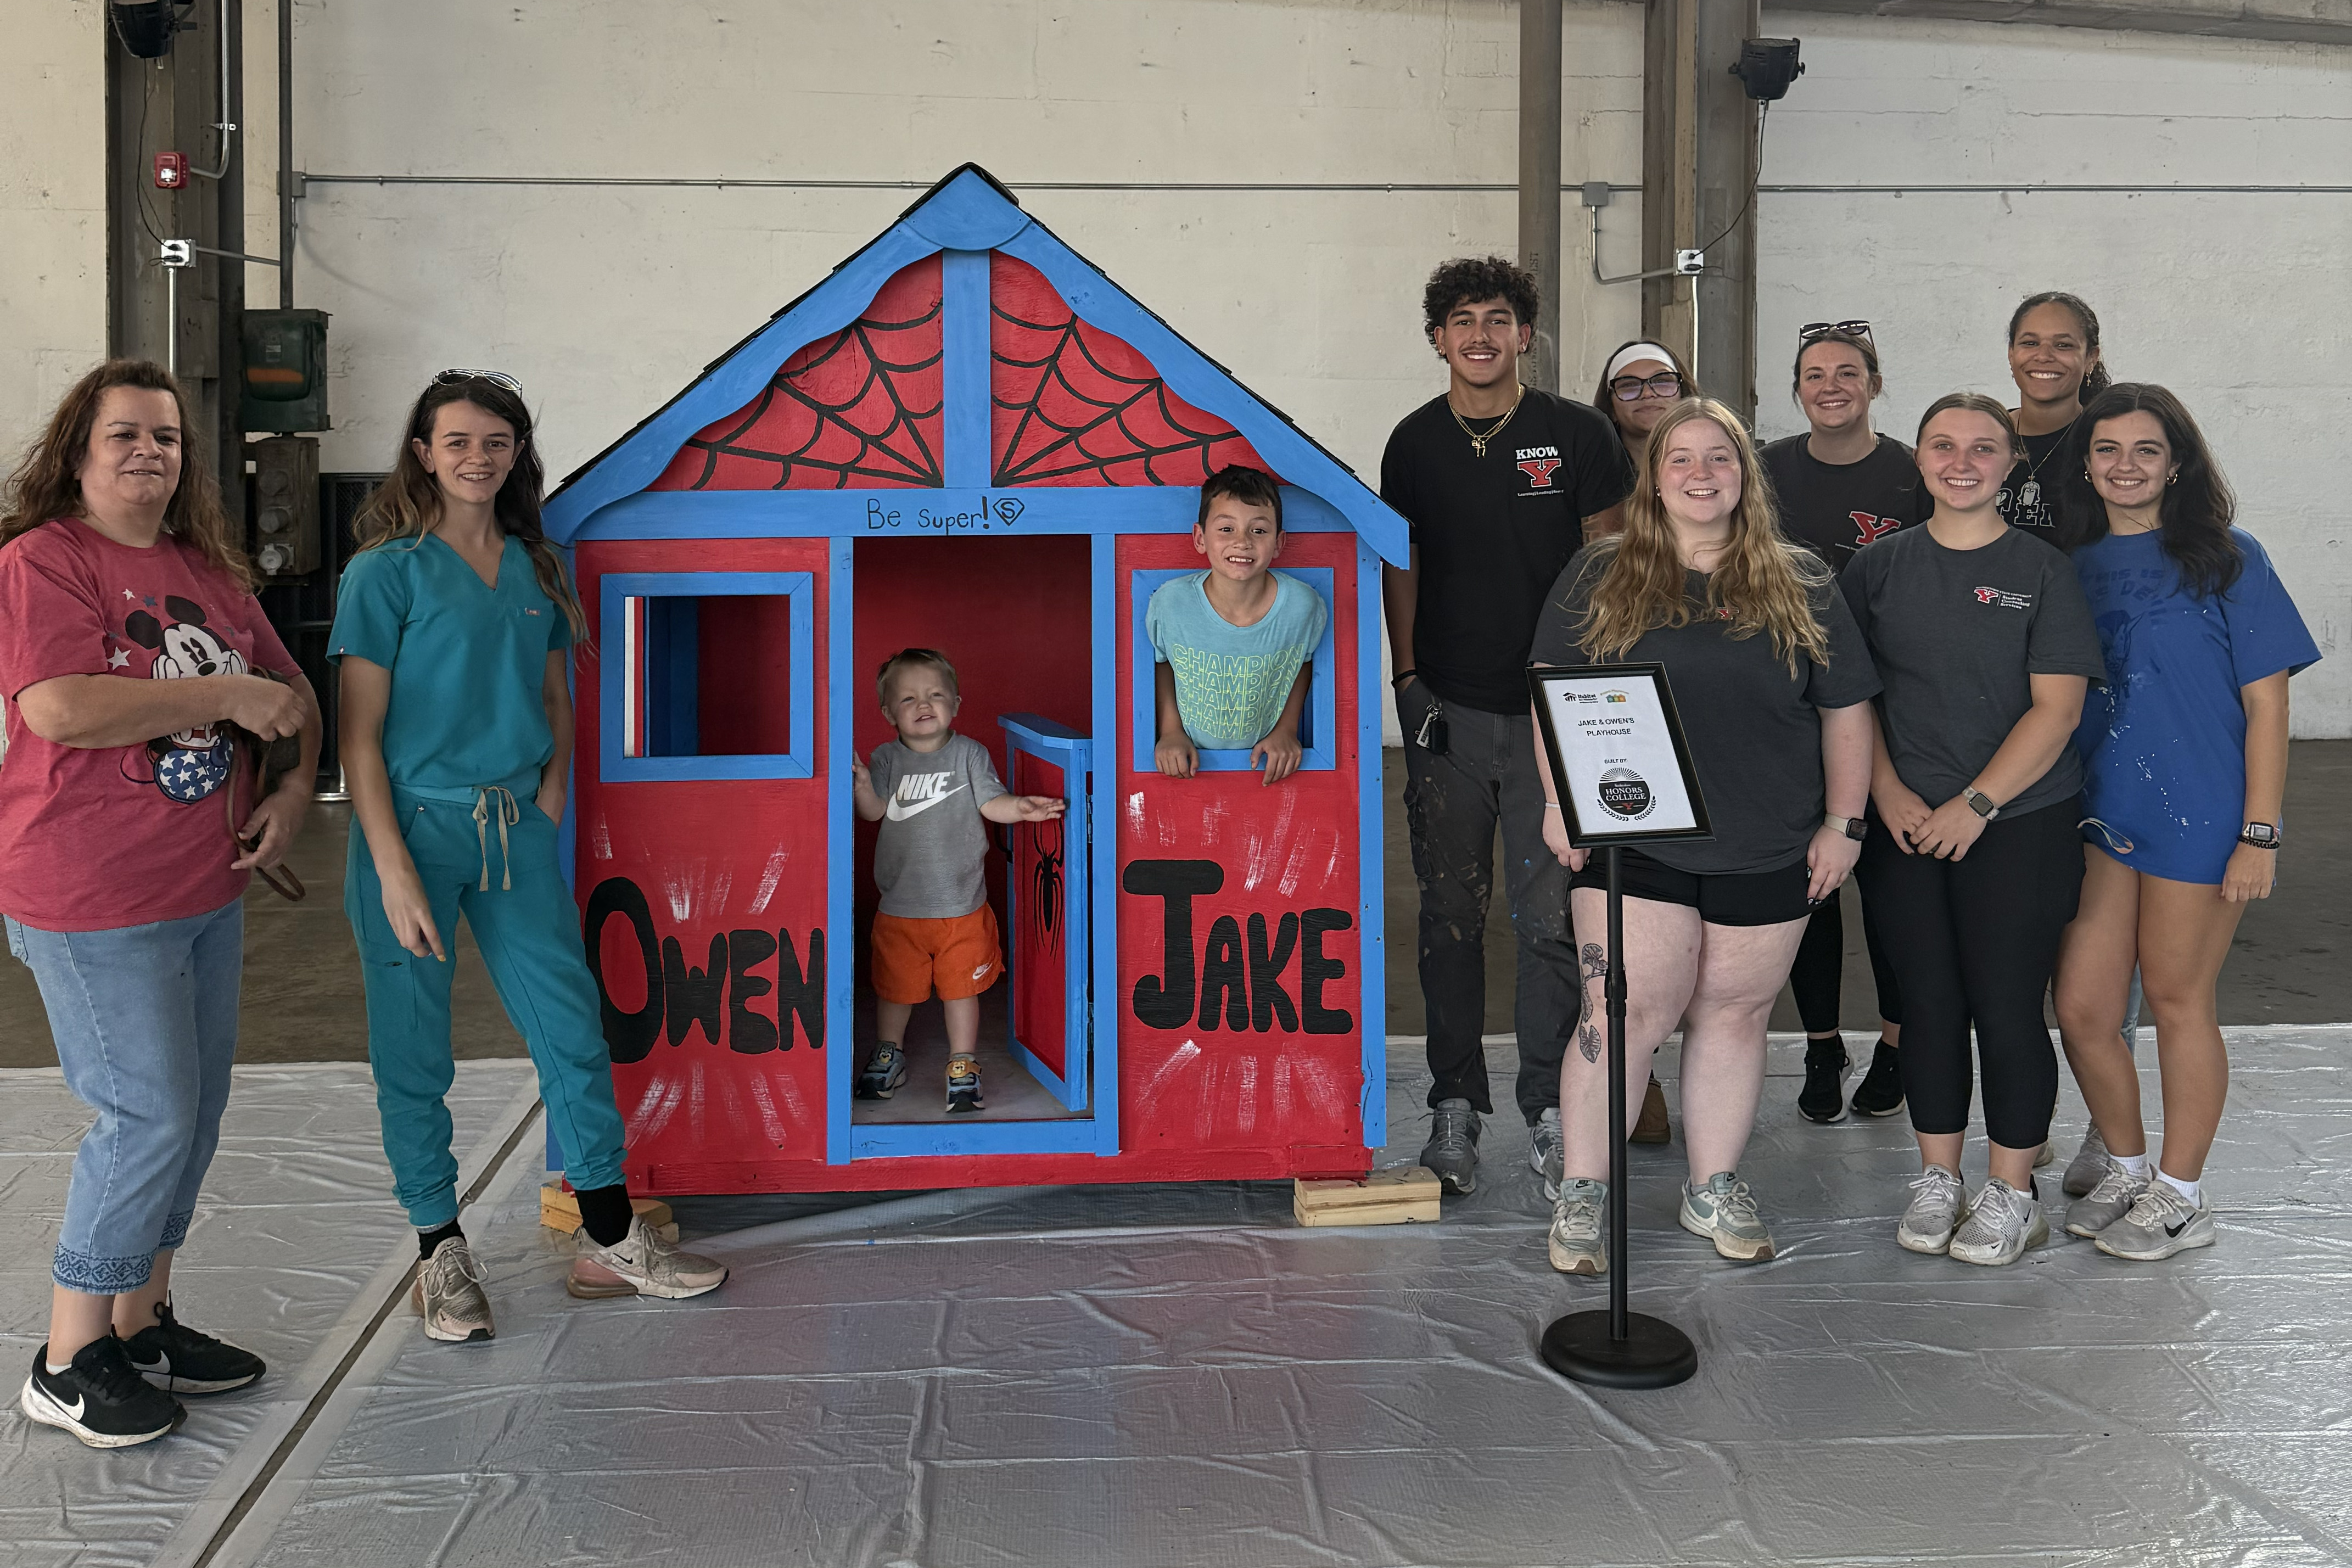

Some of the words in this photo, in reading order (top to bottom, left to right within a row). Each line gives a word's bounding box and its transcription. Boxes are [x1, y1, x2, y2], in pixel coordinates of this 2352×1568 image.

[1515, 446, 1558, 460] KNOW
[1517, 458, 1561, 488] Y
[867, 498, 901, 529] Be
[1849, 511, 1902, 545] Y
[1172, 643, 1305, 677] CHAMPION
[897, 772, 951, 801] NIKE
[1605, 787, 1643, 795] HONORS
[1122, 859, 1353, 1034] JAKE
[584, 876, 825, 1064] OWEN
